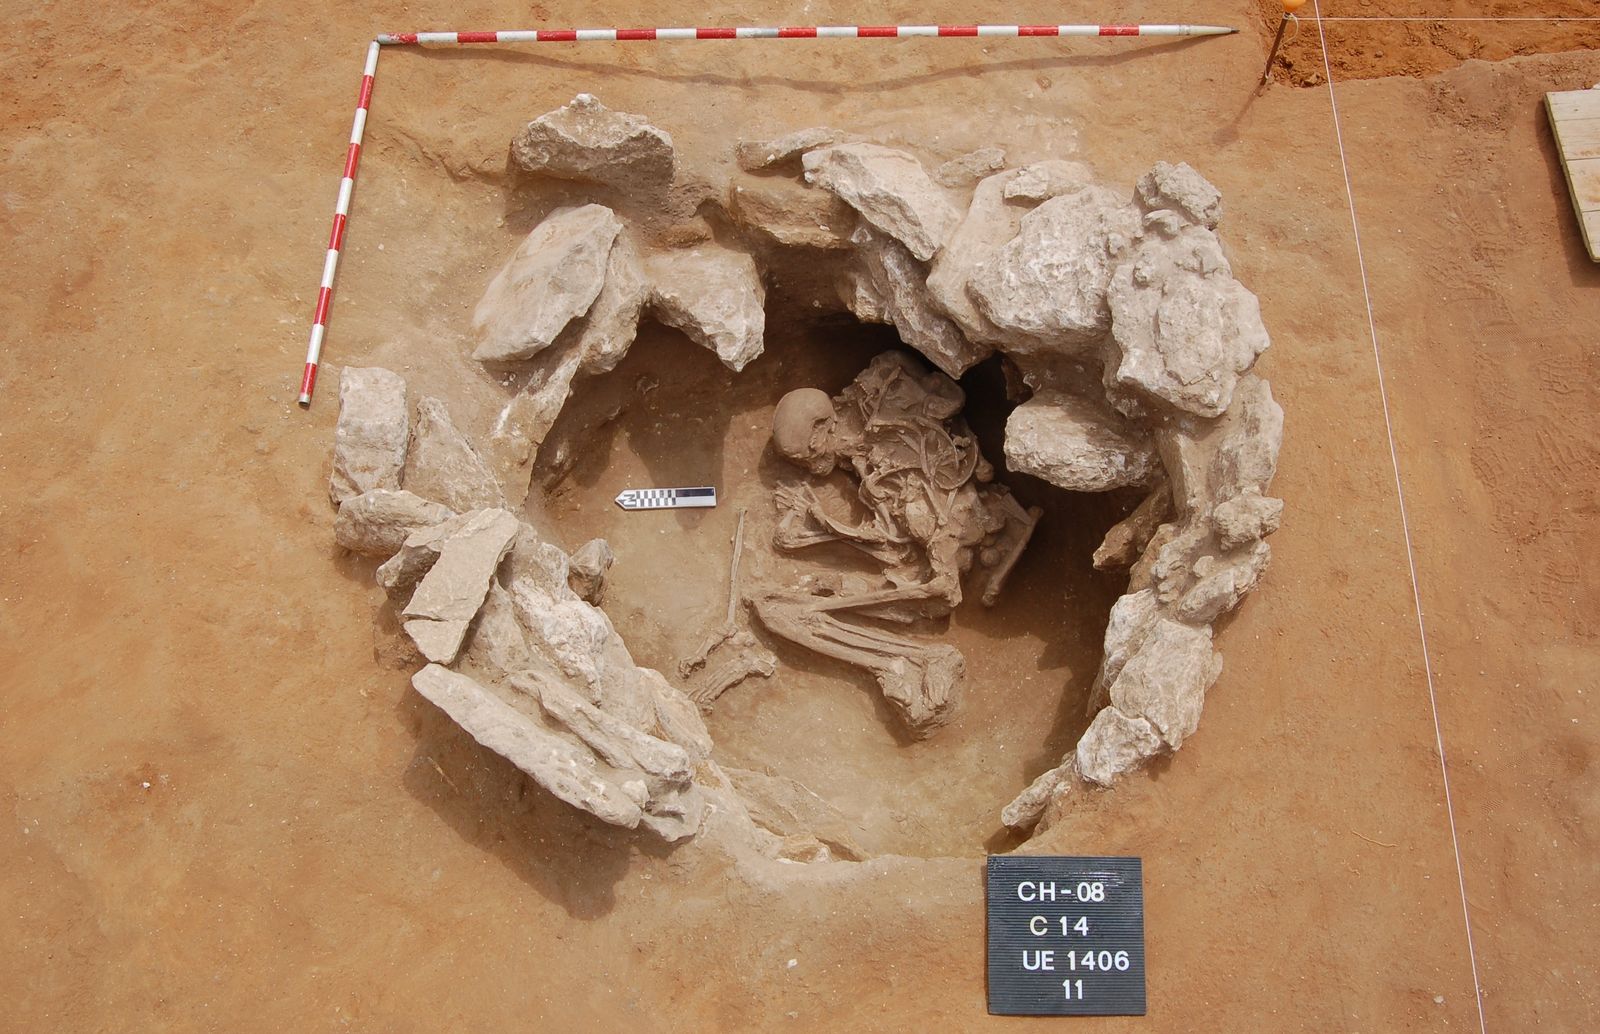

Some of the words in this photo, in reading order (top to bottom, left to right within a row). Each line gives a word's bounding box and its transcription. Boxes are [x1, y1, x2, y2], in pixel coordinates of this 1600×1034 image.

[1017, 881, 1105, 902] CH-08
[1029, 915, 1048, 936] C
[1059, 915, 1089, 936] 14
[1022, 950, 1055, 971] UE
[1067, 950, 1130, 971] 1406
[1062, 979, 1083, 1000] 11
